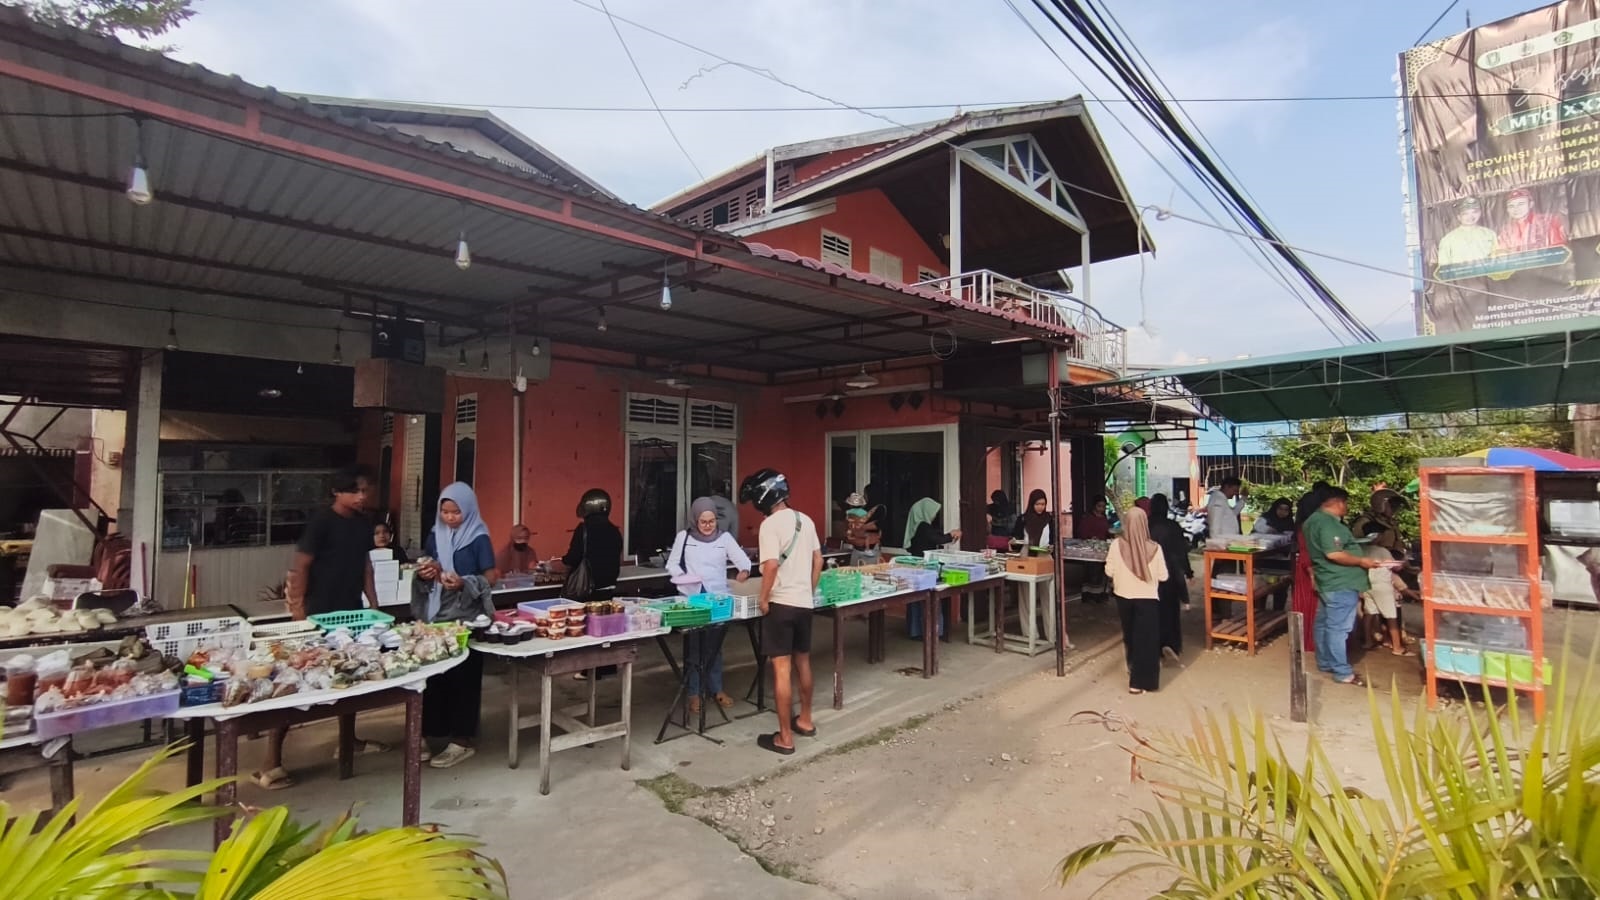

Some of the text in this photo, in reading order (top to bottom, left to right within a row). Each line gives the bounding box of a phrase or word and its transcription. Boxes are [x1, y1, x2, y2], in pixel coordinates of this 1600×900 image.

[1510, 107, 1556, 129] MTQ
[1539, 121, 1599, 142] TINGKAT
[1467, 134, 1600, 170] PROVINSI KALIMAN
[1483, 154, 1564, 178] KABUPATEN
[1568, 146, 1600, 160] KAY
[1530, 164, 1578, 181] TAHUN
[1475, 308, 1549, 321] Membumikan
[1488, 301, 1529, 312] Merajut
[1472, 320, 1511, 330] Menuju
[1514, 312, 1579, 325] Kalimantan
